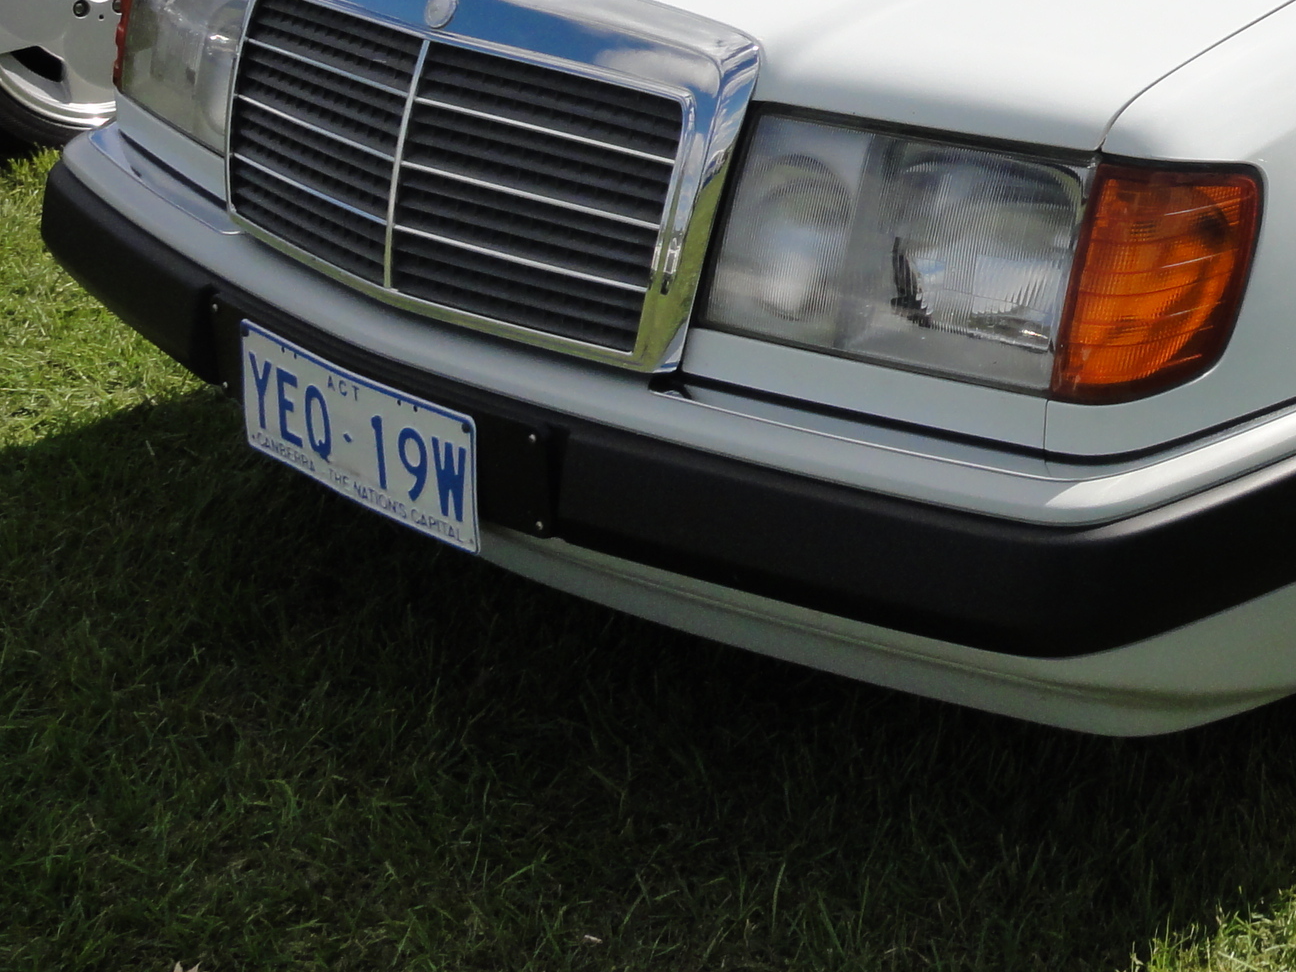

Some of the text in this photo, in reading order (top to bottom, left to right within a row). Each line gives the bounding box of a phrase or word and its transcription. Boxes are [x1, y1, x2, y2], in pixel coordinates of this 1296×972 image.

[327, 376, 360, 401] ACT
[257, 431, 316, 473] CANBERRA
[328, 468, 349, 490] THE
[411, 509, 463, 544] CAPITAL
